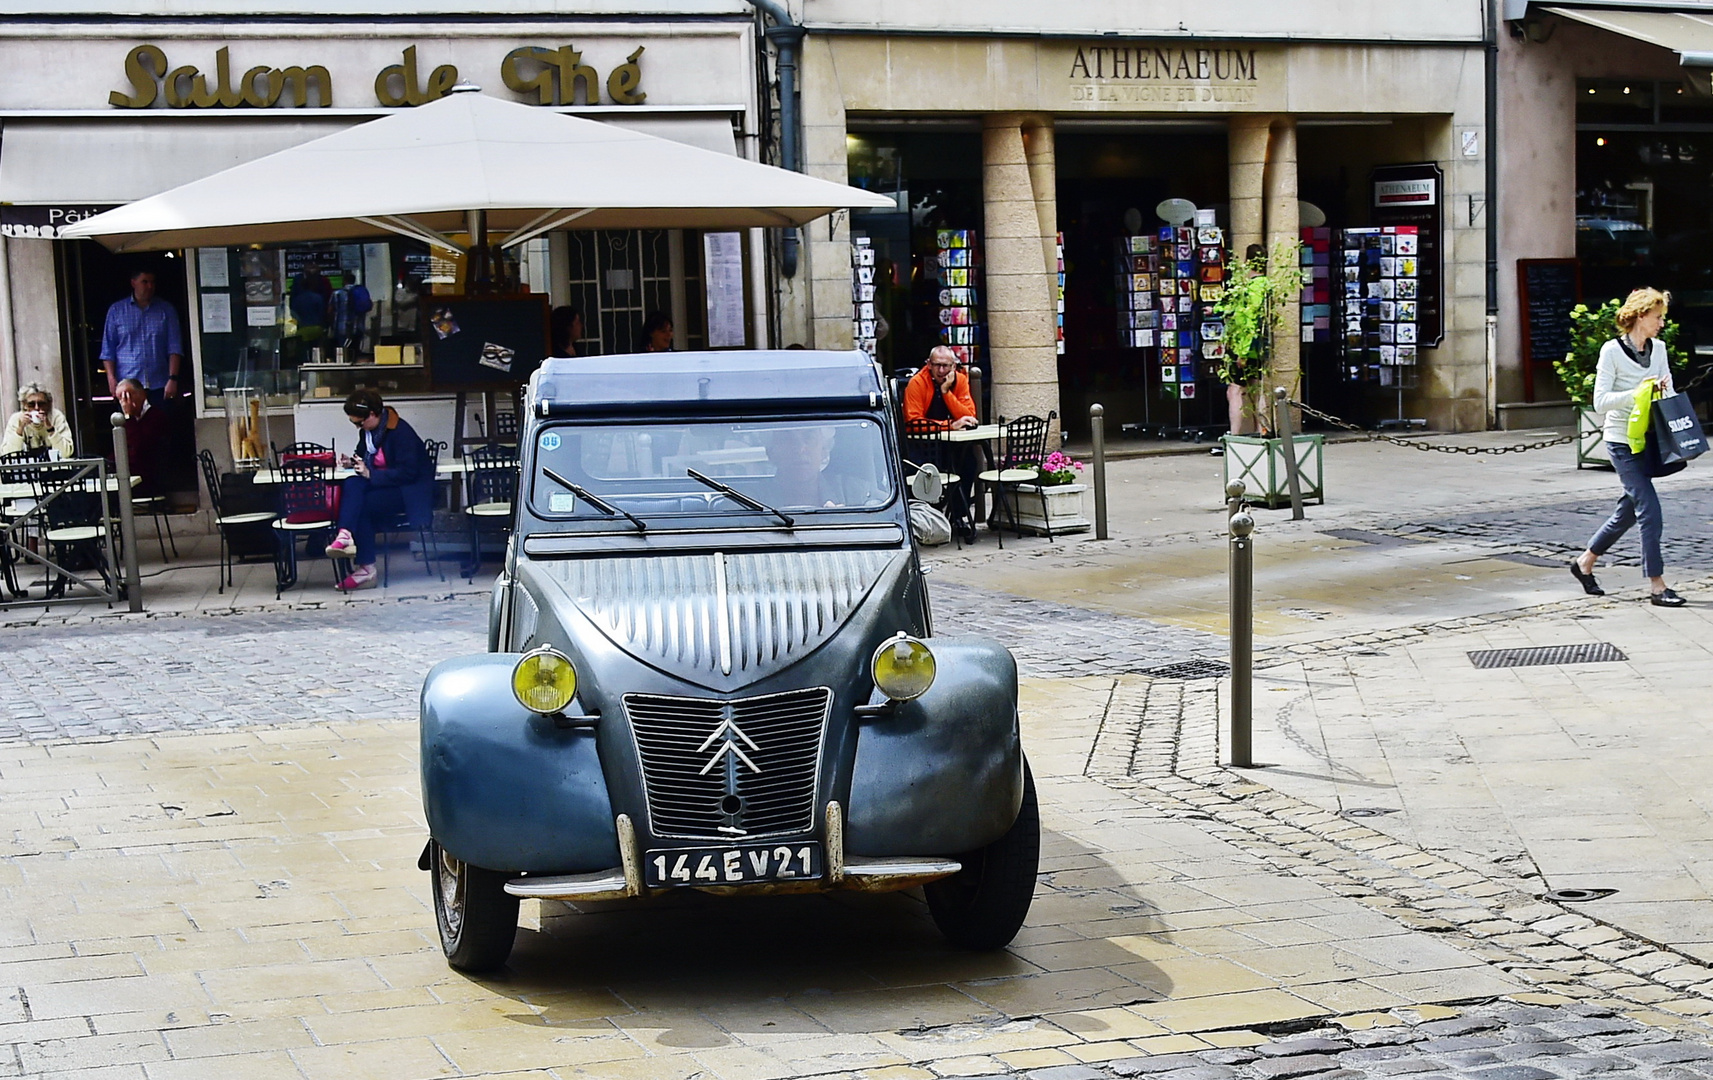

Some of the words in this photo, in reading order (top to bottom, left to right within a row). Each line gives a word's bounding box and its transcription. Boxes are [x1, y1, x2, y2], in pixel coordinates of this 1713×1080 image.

[108, 44, 332, 108] Salon
[374, 44, 458, 107] de
[501, 44, 647, 106] Thé
[1069, 45, 1258, 81] ATHENAEUM
[1073, 86, 1093, 101] DE
[1098, 86, 1118, 102] LA
[1122, 87, 1170, 102] VIGNE
[1176, 87, 1195, 102] ET
[1228, 87, 1254, 102] VIN
[1381, 183, 1430, 194] ATHENAEUM
